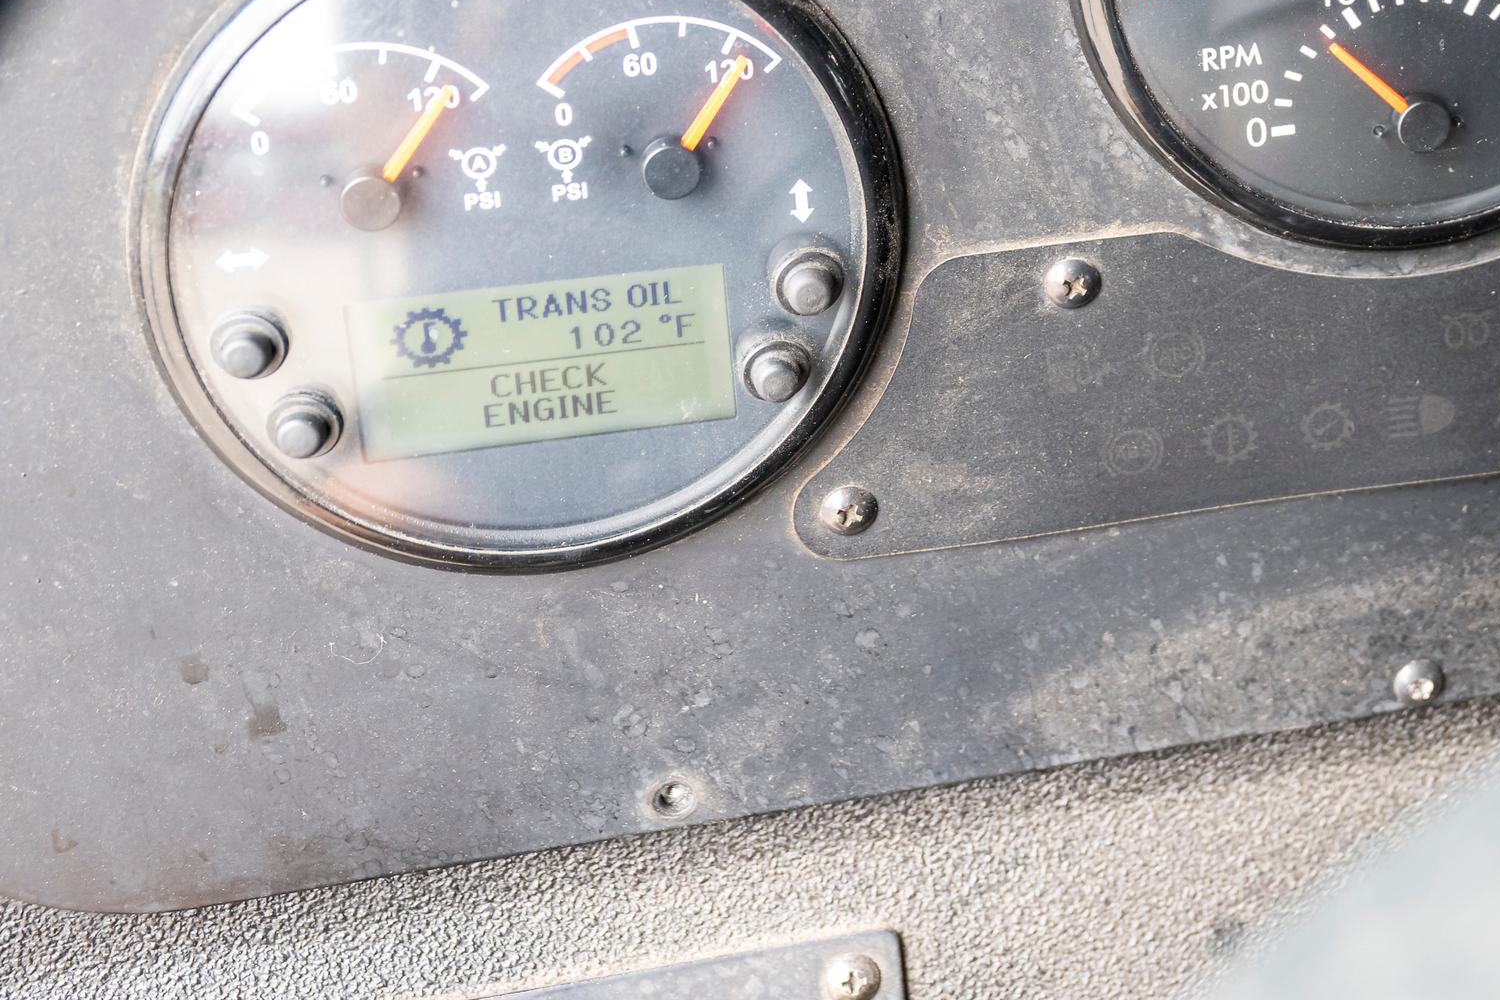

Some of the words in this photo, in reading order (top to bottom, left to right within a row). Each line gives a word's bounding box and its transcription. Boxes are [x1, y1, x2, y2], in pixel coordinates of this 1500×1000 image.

[623, 52, 657, 77] 60
[1201, 43, 1263, 72] RPM
[1201, 80, 1269, 111] x100
[554, 102, 573, 126] 0
[250, 131, 271, 156] 0
[1246, 117, 1268, 148] 0
[471, 155, 488, 173] A
[464, 191, 501, 211] PSI
[551, 182, 588, 202] PSI
[492, 287, 612, 324] TRANS
[627, 280, 683, 309] OIL
[570, 320, 642, 351] 102
[658, 313, 697, 338] °F
[490, 362, 609, 398] CHECK
[483, 390, 618, 428] ENGINE
